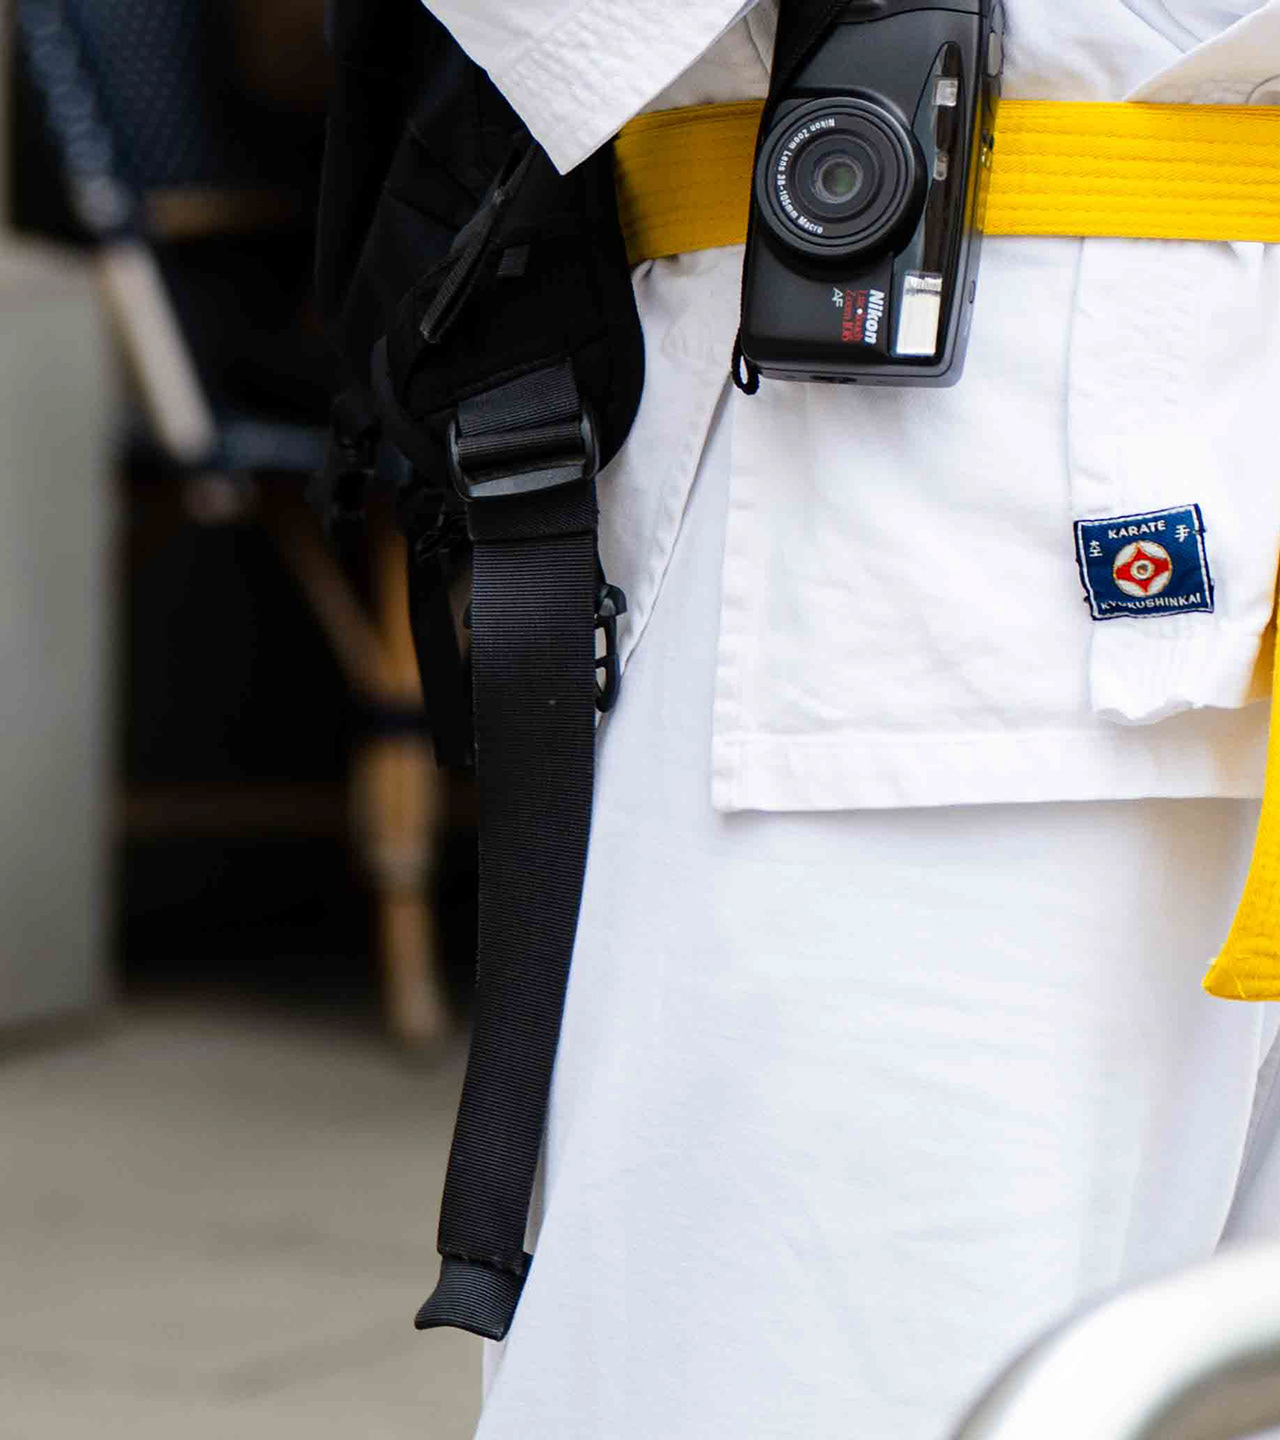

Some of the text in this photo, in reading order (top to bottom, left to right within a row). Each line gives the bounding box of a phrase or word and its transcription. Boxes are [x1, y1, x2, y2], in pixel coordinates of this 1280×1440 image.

[810, 118, 836, 132] Nikon
[788, 129, 810, 150] Zoom
[778, 150, 792, 171] Lens
[797, 215, 824, 234] Macro
[832, 287, 843, 307] AF
[864, 288, 885, 345] Nikon
[1108, 520, 1166, 539] KARATE
[1174, 524, 1191, 542] 手
